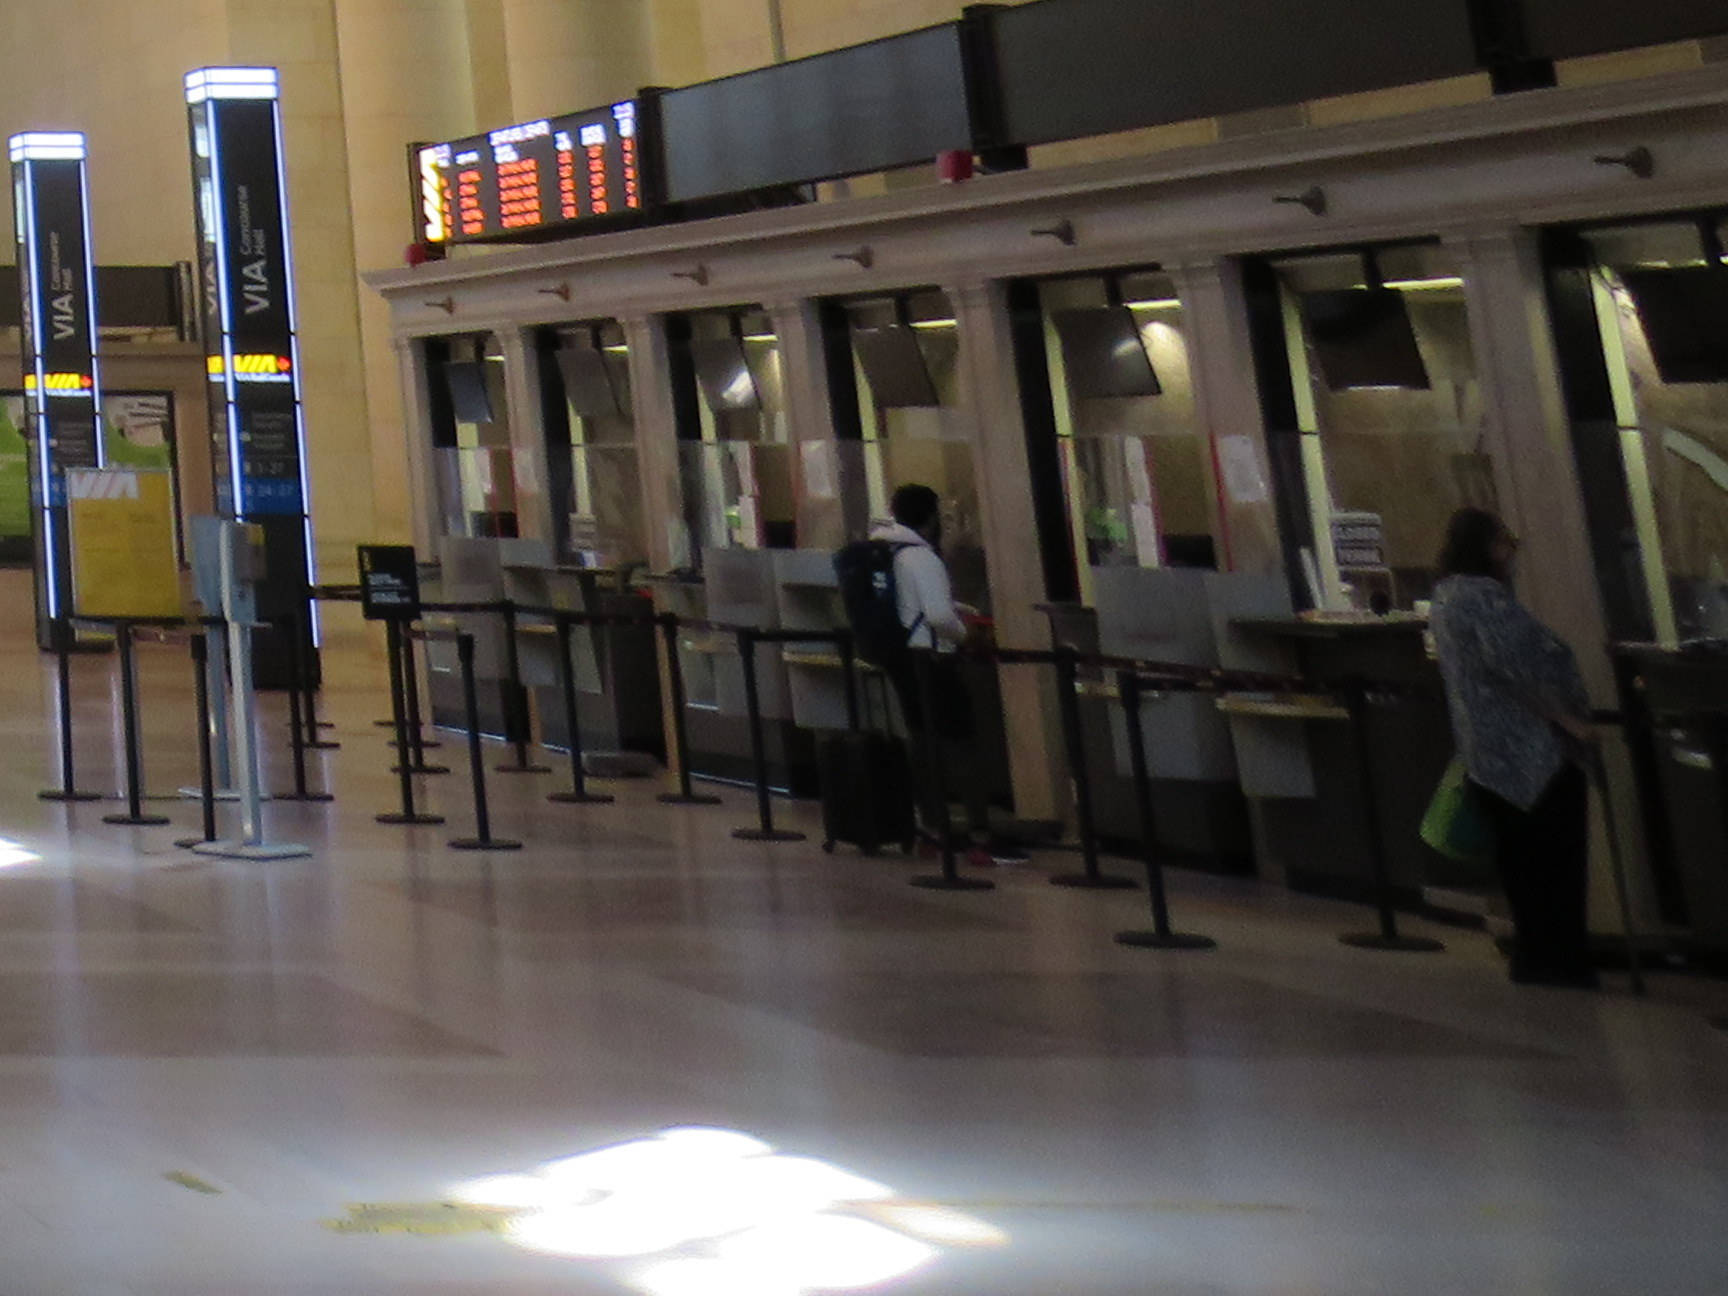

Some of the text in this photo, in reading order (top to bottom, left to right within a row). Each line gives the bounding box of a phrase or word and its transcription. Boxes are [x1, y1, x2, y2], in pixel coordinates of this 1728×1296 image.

[242, 260, 270, 314] VIA
[51, 294, 75, 340] VIA
[233, 354, 278, 374] VIA
